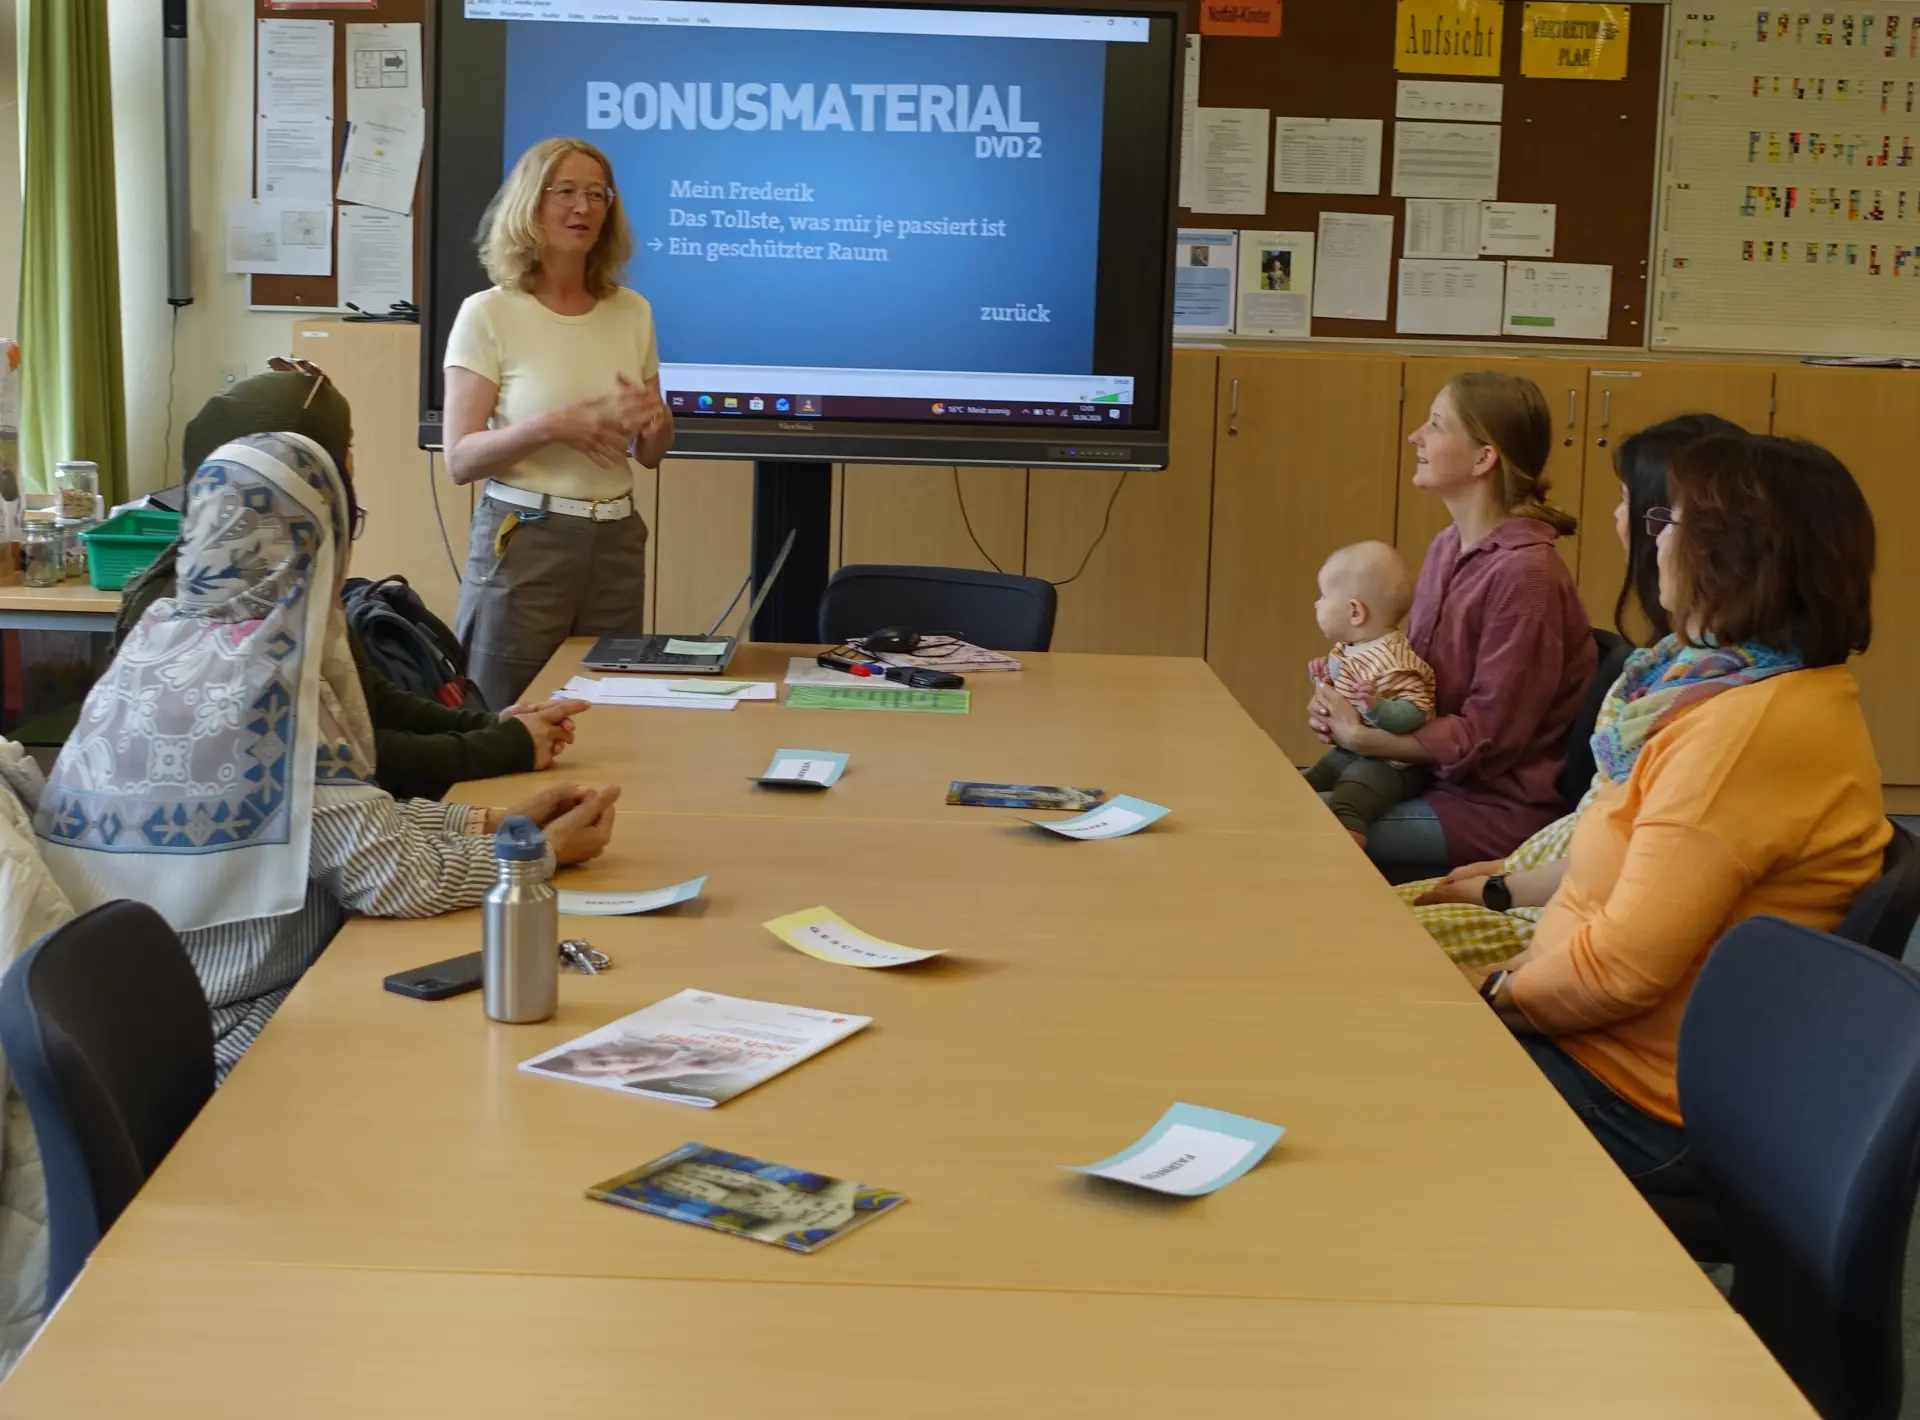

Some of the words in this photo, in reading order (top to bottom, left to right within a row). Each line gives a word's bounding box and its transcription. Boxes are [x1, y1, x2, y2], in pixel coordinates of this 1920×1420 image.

[1405, 14, 1495, 57] Aufsicht
[1557, 48, 1591, 67] PLAN
[587, 81, 1039, 133] BONUSMATERIAL
[975, 136, 1024, 158] DVD
[1027, 137, 1042, 158] 2
[669, 180, 724, 199] Mein
[728, 181, 814, 202] Frederik
[668, 208, 707, 227] Das
[711, 209, 784, 233] Tollste,
[789, 216, 830, 231] was
[834, 215, 872, 232] mir
[873, 215, 894, 238] je
[898, 217, 977, 239] passiert
[980, 218, 1007, 236] ist
[668, 237, 703, 256] Ein
[706, 239, 824, 262] geschützter
[827, 242, 889, 261] Raum
[980, 303, 1051, 322] zurück
